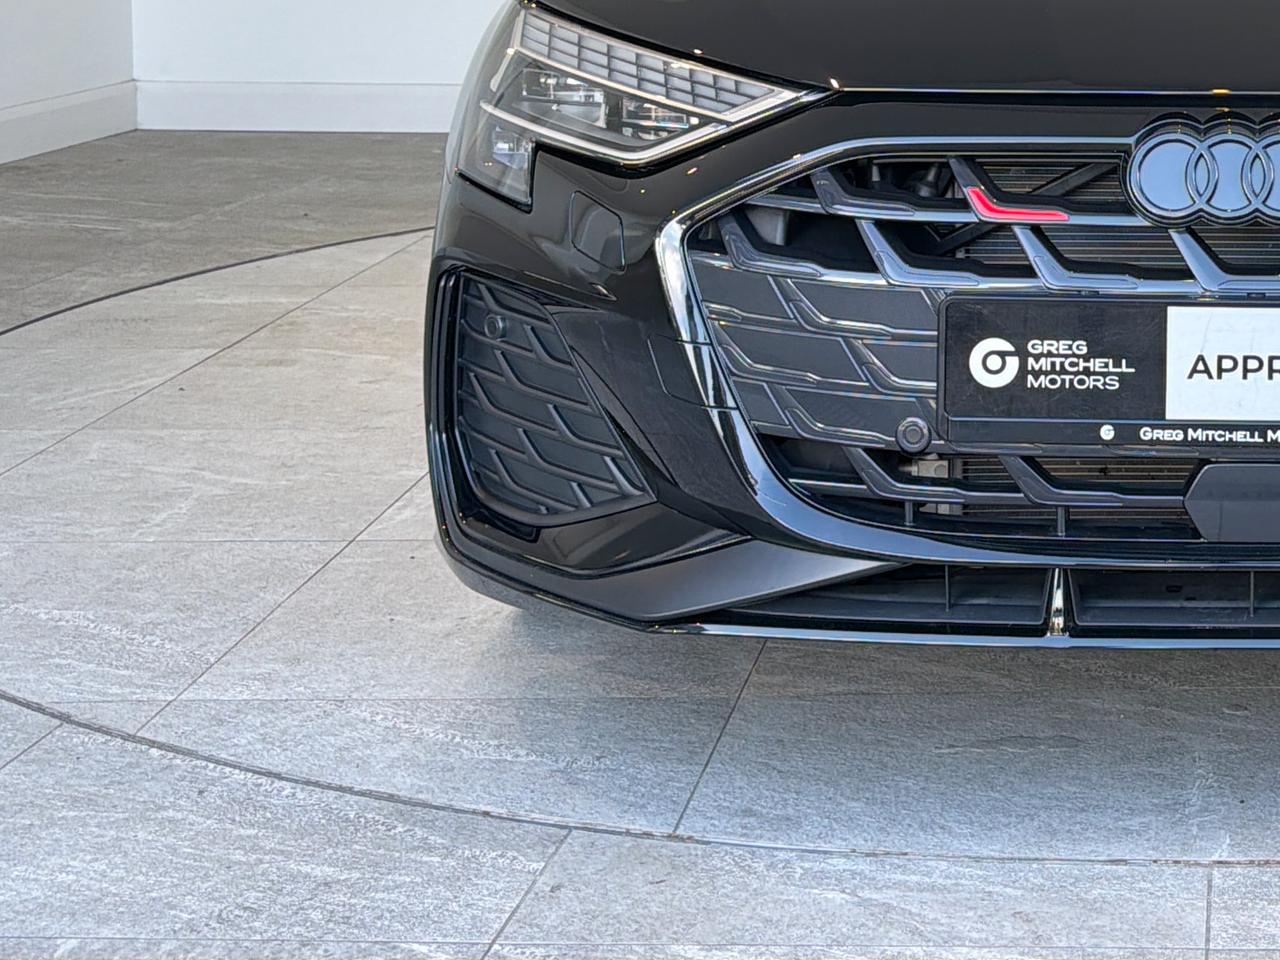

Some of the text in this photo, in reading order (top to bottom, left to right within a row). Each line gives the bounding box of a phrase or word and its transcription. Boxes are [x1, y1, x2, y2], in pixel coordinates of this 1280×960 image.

[1027, 340, 1087, 354] GREG
[1027, 357, 1135, 373] MITCHELL
[1027, 374, 1120, 390] MOTORS
